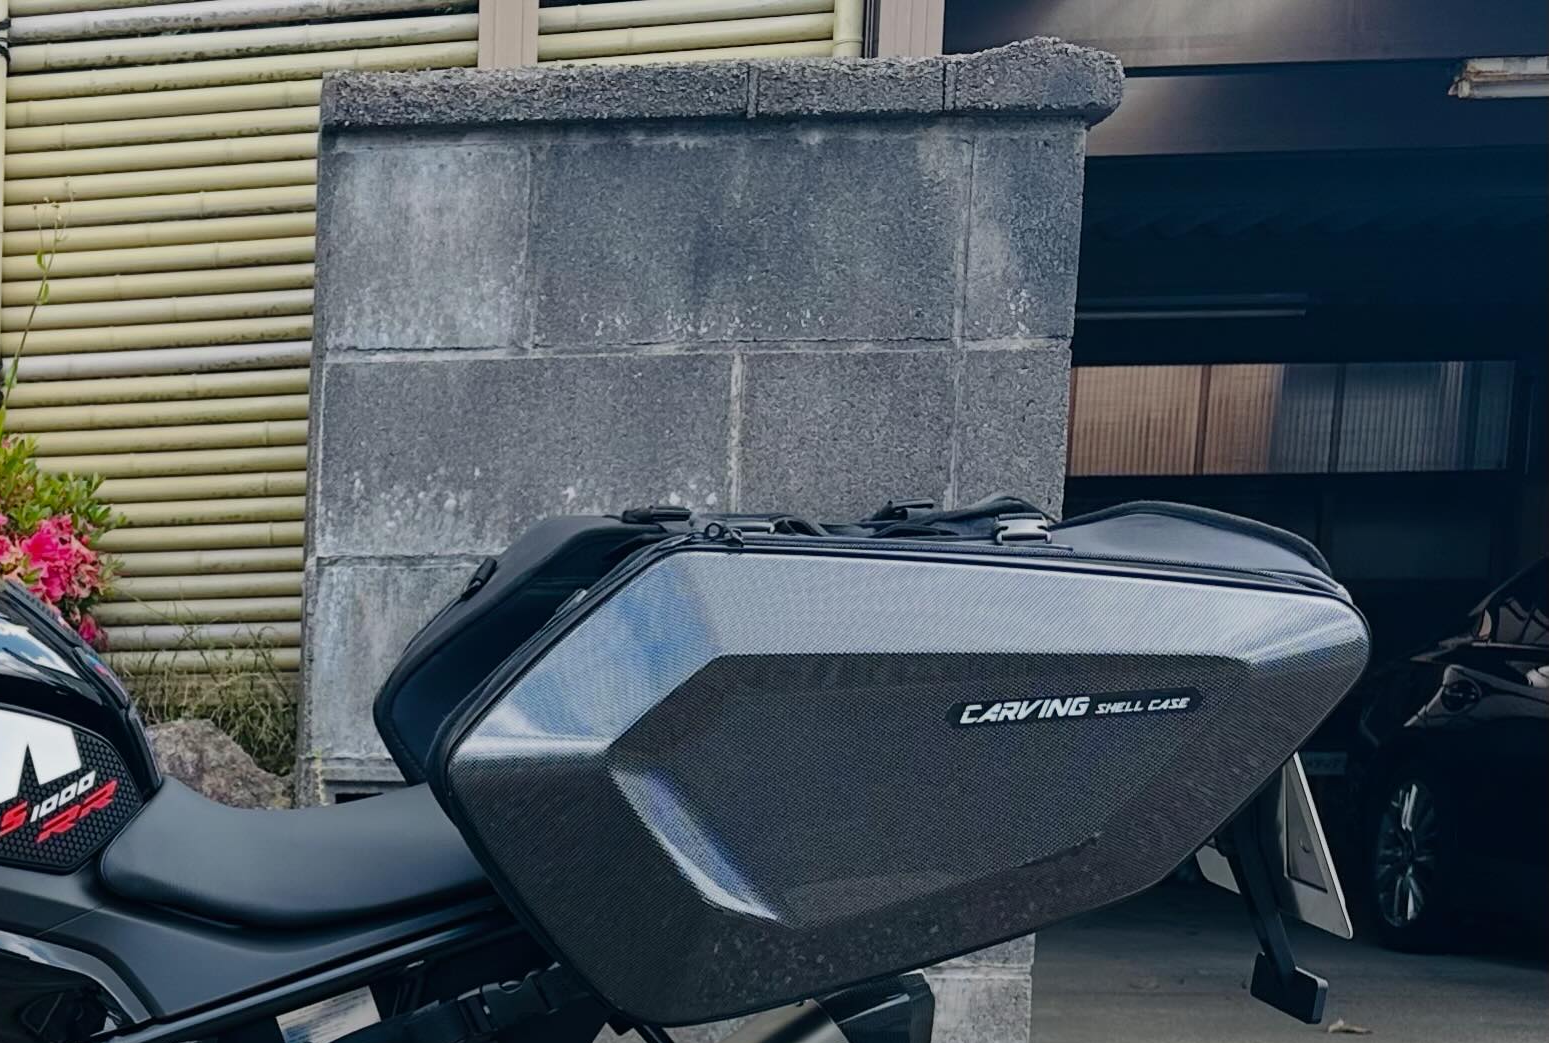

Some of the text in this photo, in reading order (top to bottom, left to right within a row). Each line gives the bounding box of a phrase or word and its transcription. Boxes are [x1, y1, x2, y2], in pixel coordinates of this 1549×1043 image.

[960, 697, 1190, 724] CARVING SHELL CASE
